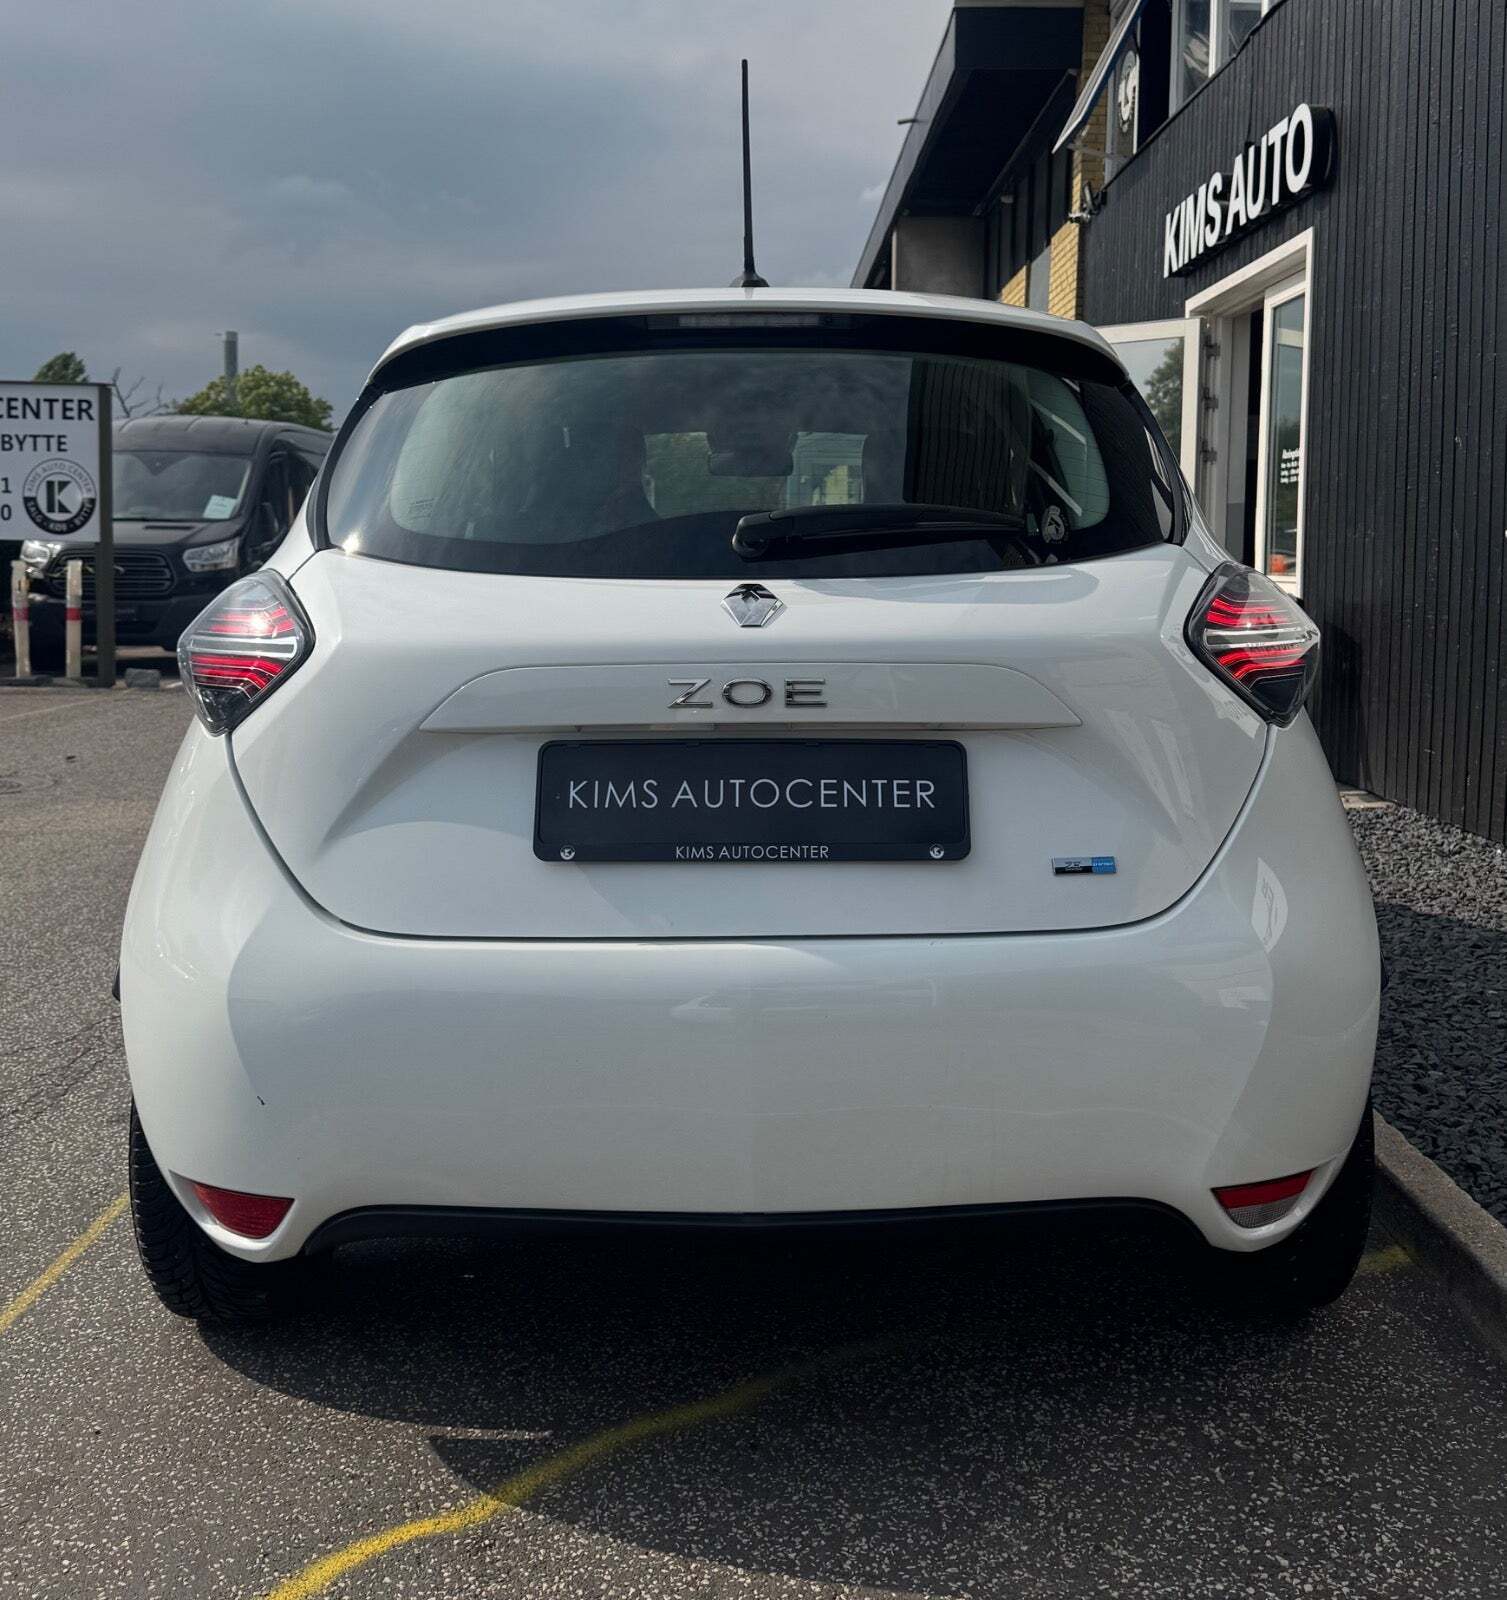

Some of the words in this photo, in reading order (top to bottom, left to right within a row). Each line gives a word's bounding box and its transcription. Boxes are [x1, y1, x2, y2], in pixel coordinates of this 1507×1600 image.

[1164, 172, 1222, 279] KIMS
[1225, 103, 1313, 236] AUTO
[0, 397, 94, 421] ENTER
[1, 434, 68, 452] BYTTE
[667, 677, 828, 708] ZOE
[568, 779, 658, 808] KIMS
[671, 778, 935, 808] AUTOCENTER
[675, 846, 714, 859] KIMS
[718, 846, 829, 859] AUTOCENTER
